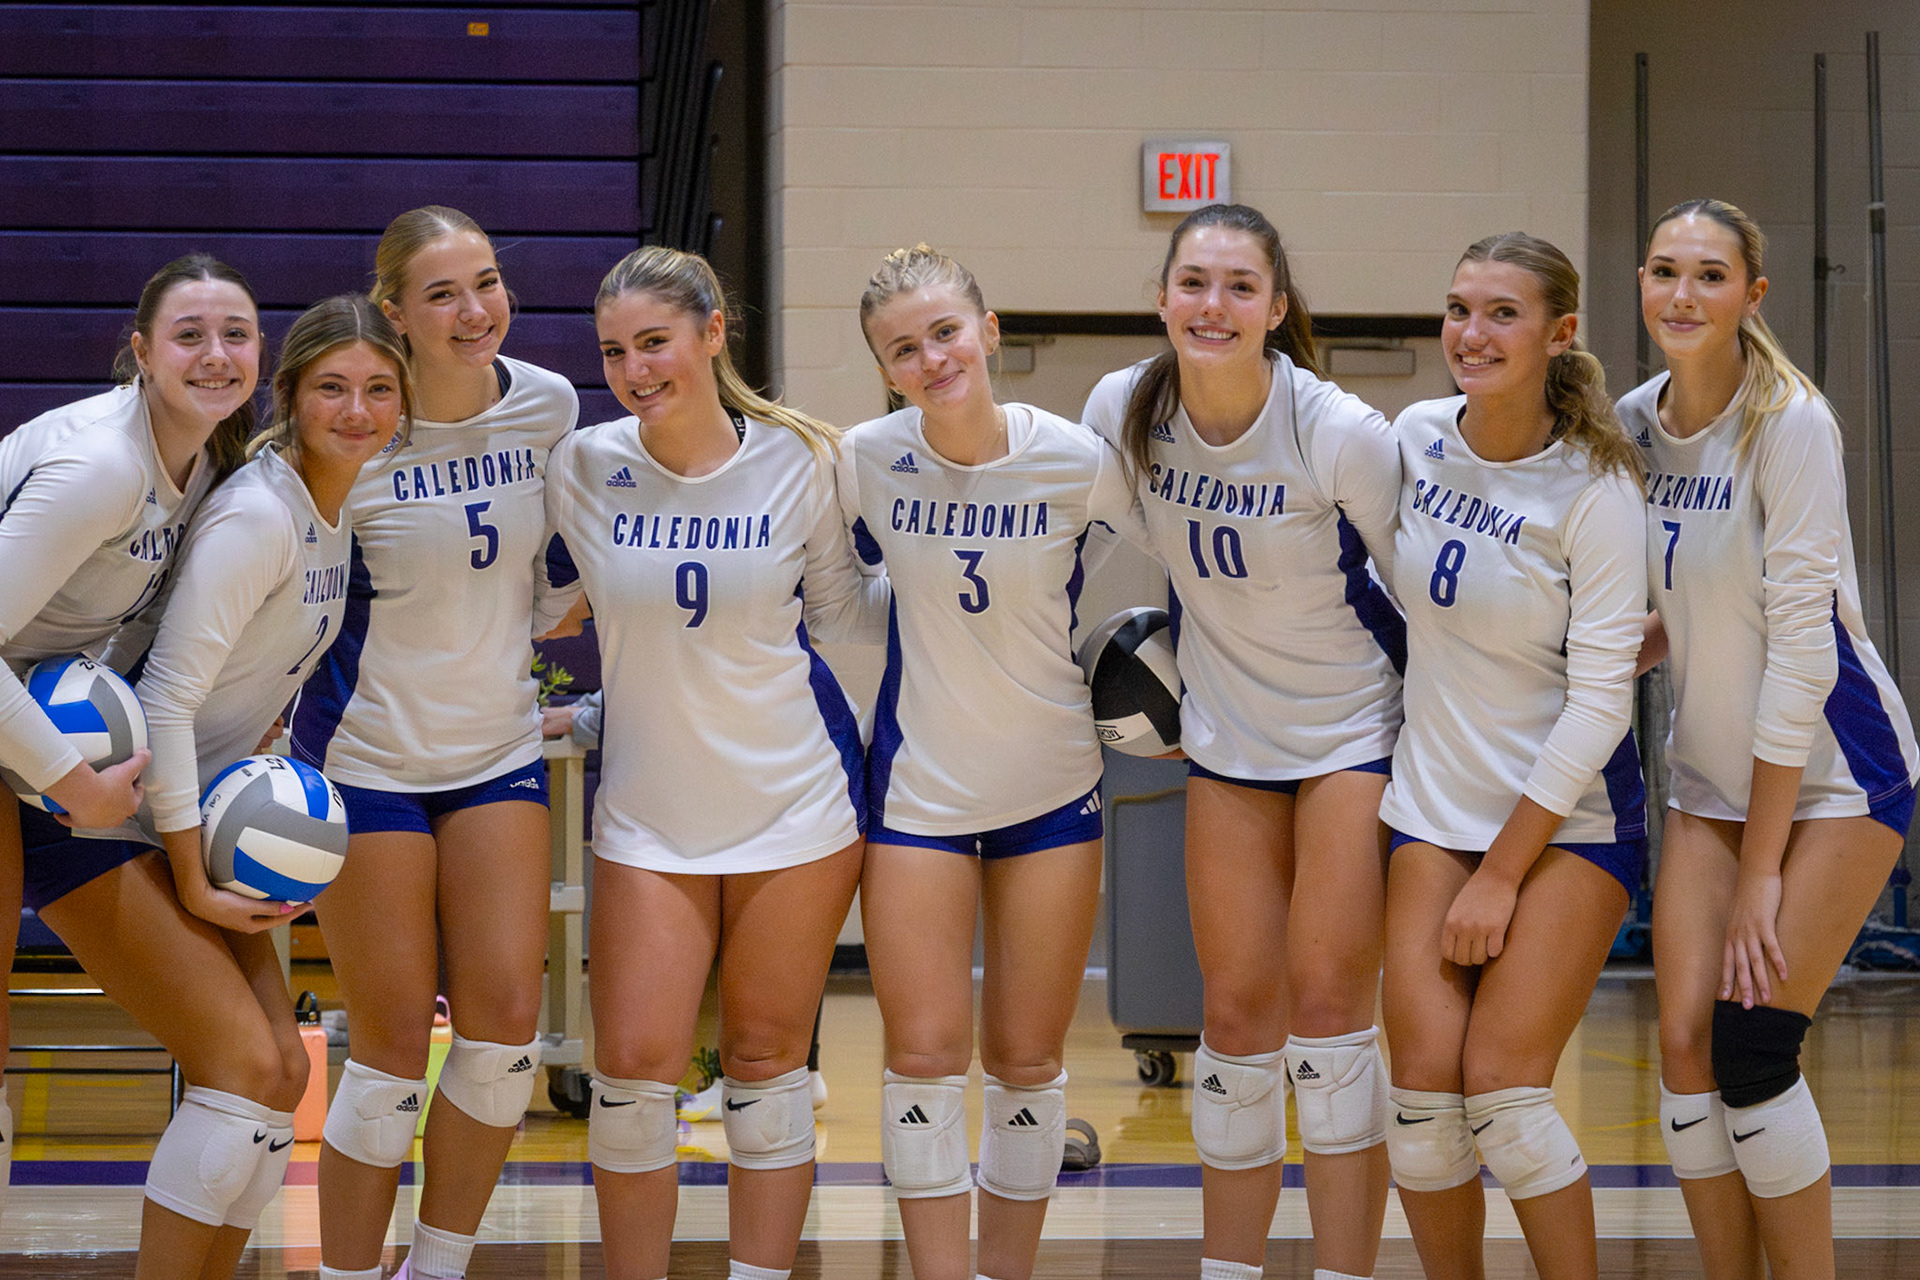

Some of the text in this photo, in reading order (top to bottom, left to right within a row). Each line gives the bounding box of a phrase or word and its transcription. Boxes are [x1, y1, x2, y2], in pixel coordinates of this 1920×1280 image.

[1159, 153, 1220, 200] EXIT
[392, 448, 535, 502] CALEDONIA
[606, 478, 637, 488] adidas
[890, 463, 919, 474] adidas
[1149, 462, 1286, 517] CALEDONIA
[1645, 472, 1733, 511] LEDONIA
[464, 501, 500, 570] 5
[613, 513, 771, 551] CALEDONIA
[891, 498, 1049, 539] CALEDONIA
[1413, 479, 1526, 546] CALEDONIA
[1186, 518, 1249, 579] 10
[1429, 539, 1467, 608] 8
[1662, 520, 1682, 591] 7
[675, 561, 709, 628] 9
[952, 549, 990, 615] 3
[287, 614, 329, 676] 2
[1201, 1082, 1227, 1096] adidas
[1296, 1071, 1321, 1080] adidas
